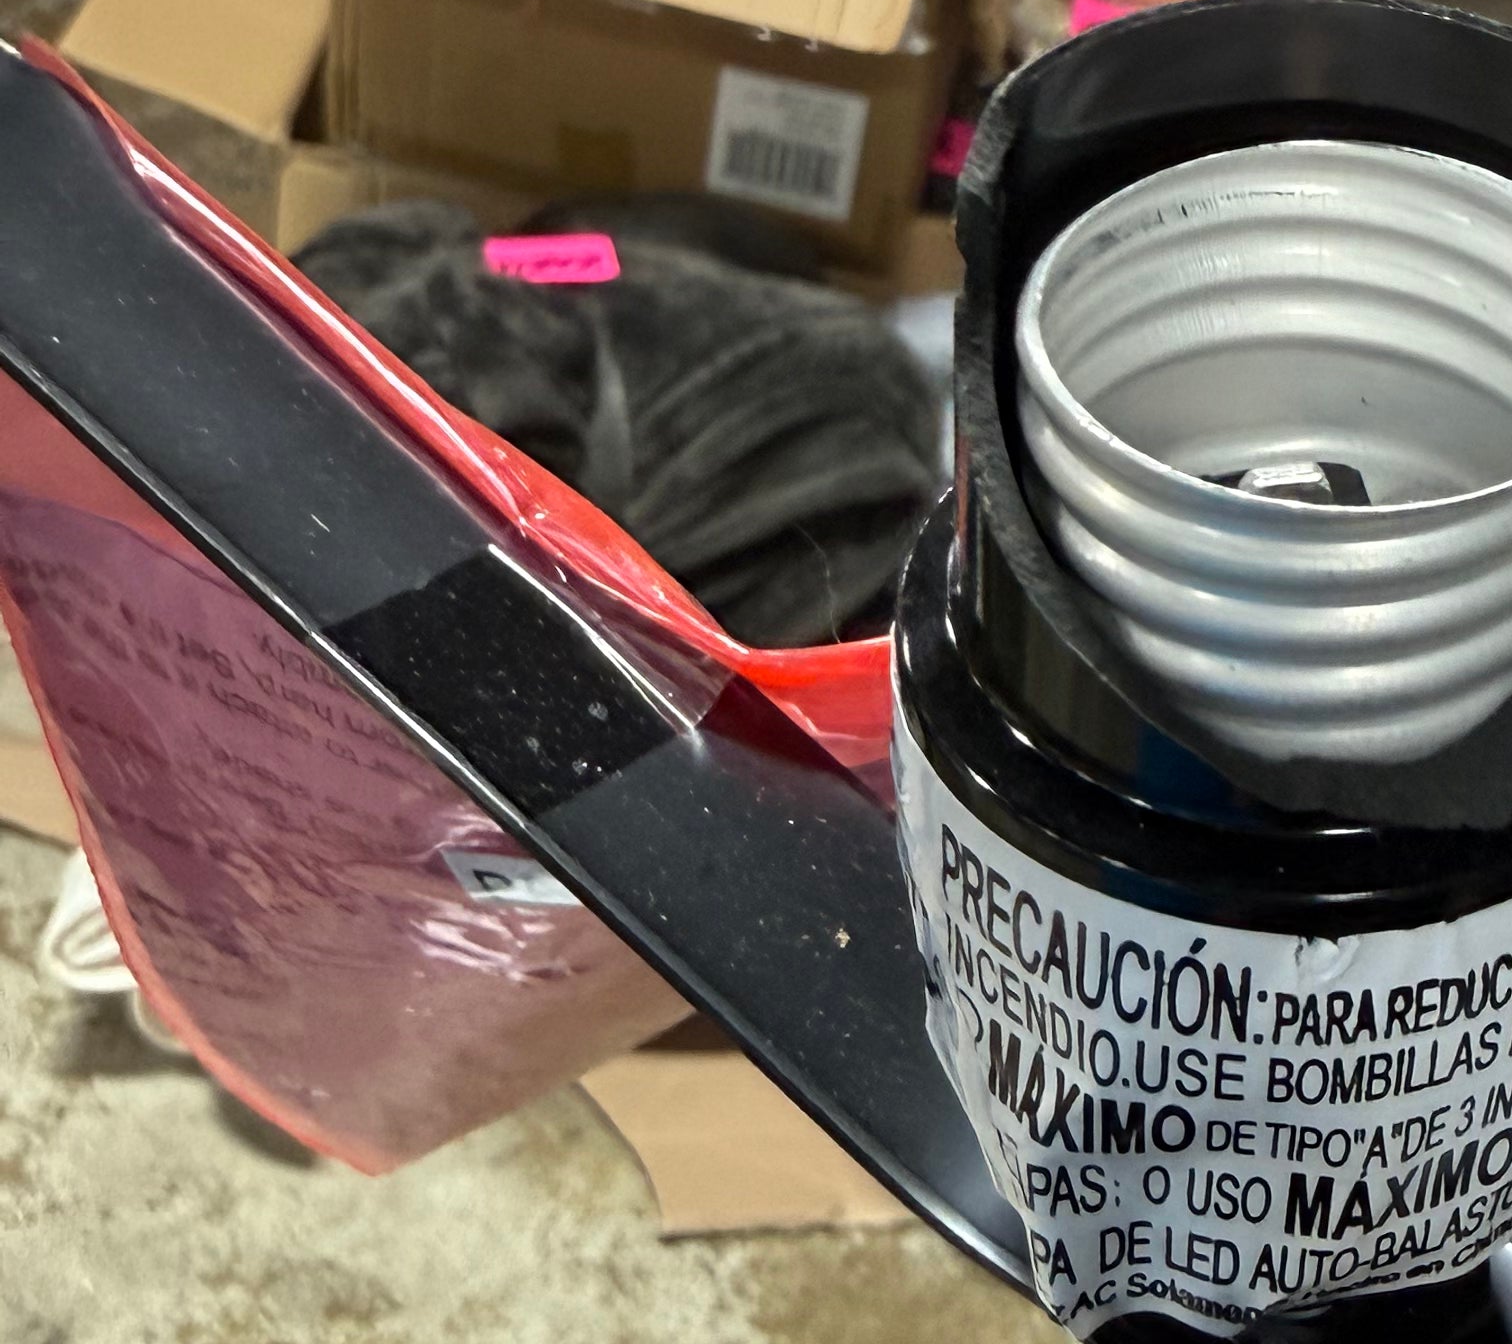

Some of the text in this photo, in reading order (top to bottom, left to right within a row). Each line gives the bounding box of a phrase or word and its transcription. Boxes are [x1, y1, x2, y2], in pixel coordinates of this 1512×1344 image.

[941, 823, 1268, 1046] PRECAUCIÓN:
[1272, 988, 1377, 1046] PARA
[988, 1018, 1197, 1155] MÁXIMO
[1206, 1120, 1257, 1156] DE
[1265, 1121, 1351, 1168] TIPO
[1401, 1105, 1451, 1163] DE
[1455, 1095, 1476, 1137] 3
[1266, 1022, 1502, 1105] BOMBILLAS
[1026, 1163, 1121, 1218] PAS:
[1143, 1165, 1171, 1205] O
[1186, 1167, 1272, 1224] USO
[1030, 1229, 1077, 1286] PA
[1100, 1220, 1153, 1275] DE
[1165, 1225, 1240, 1286] LED
